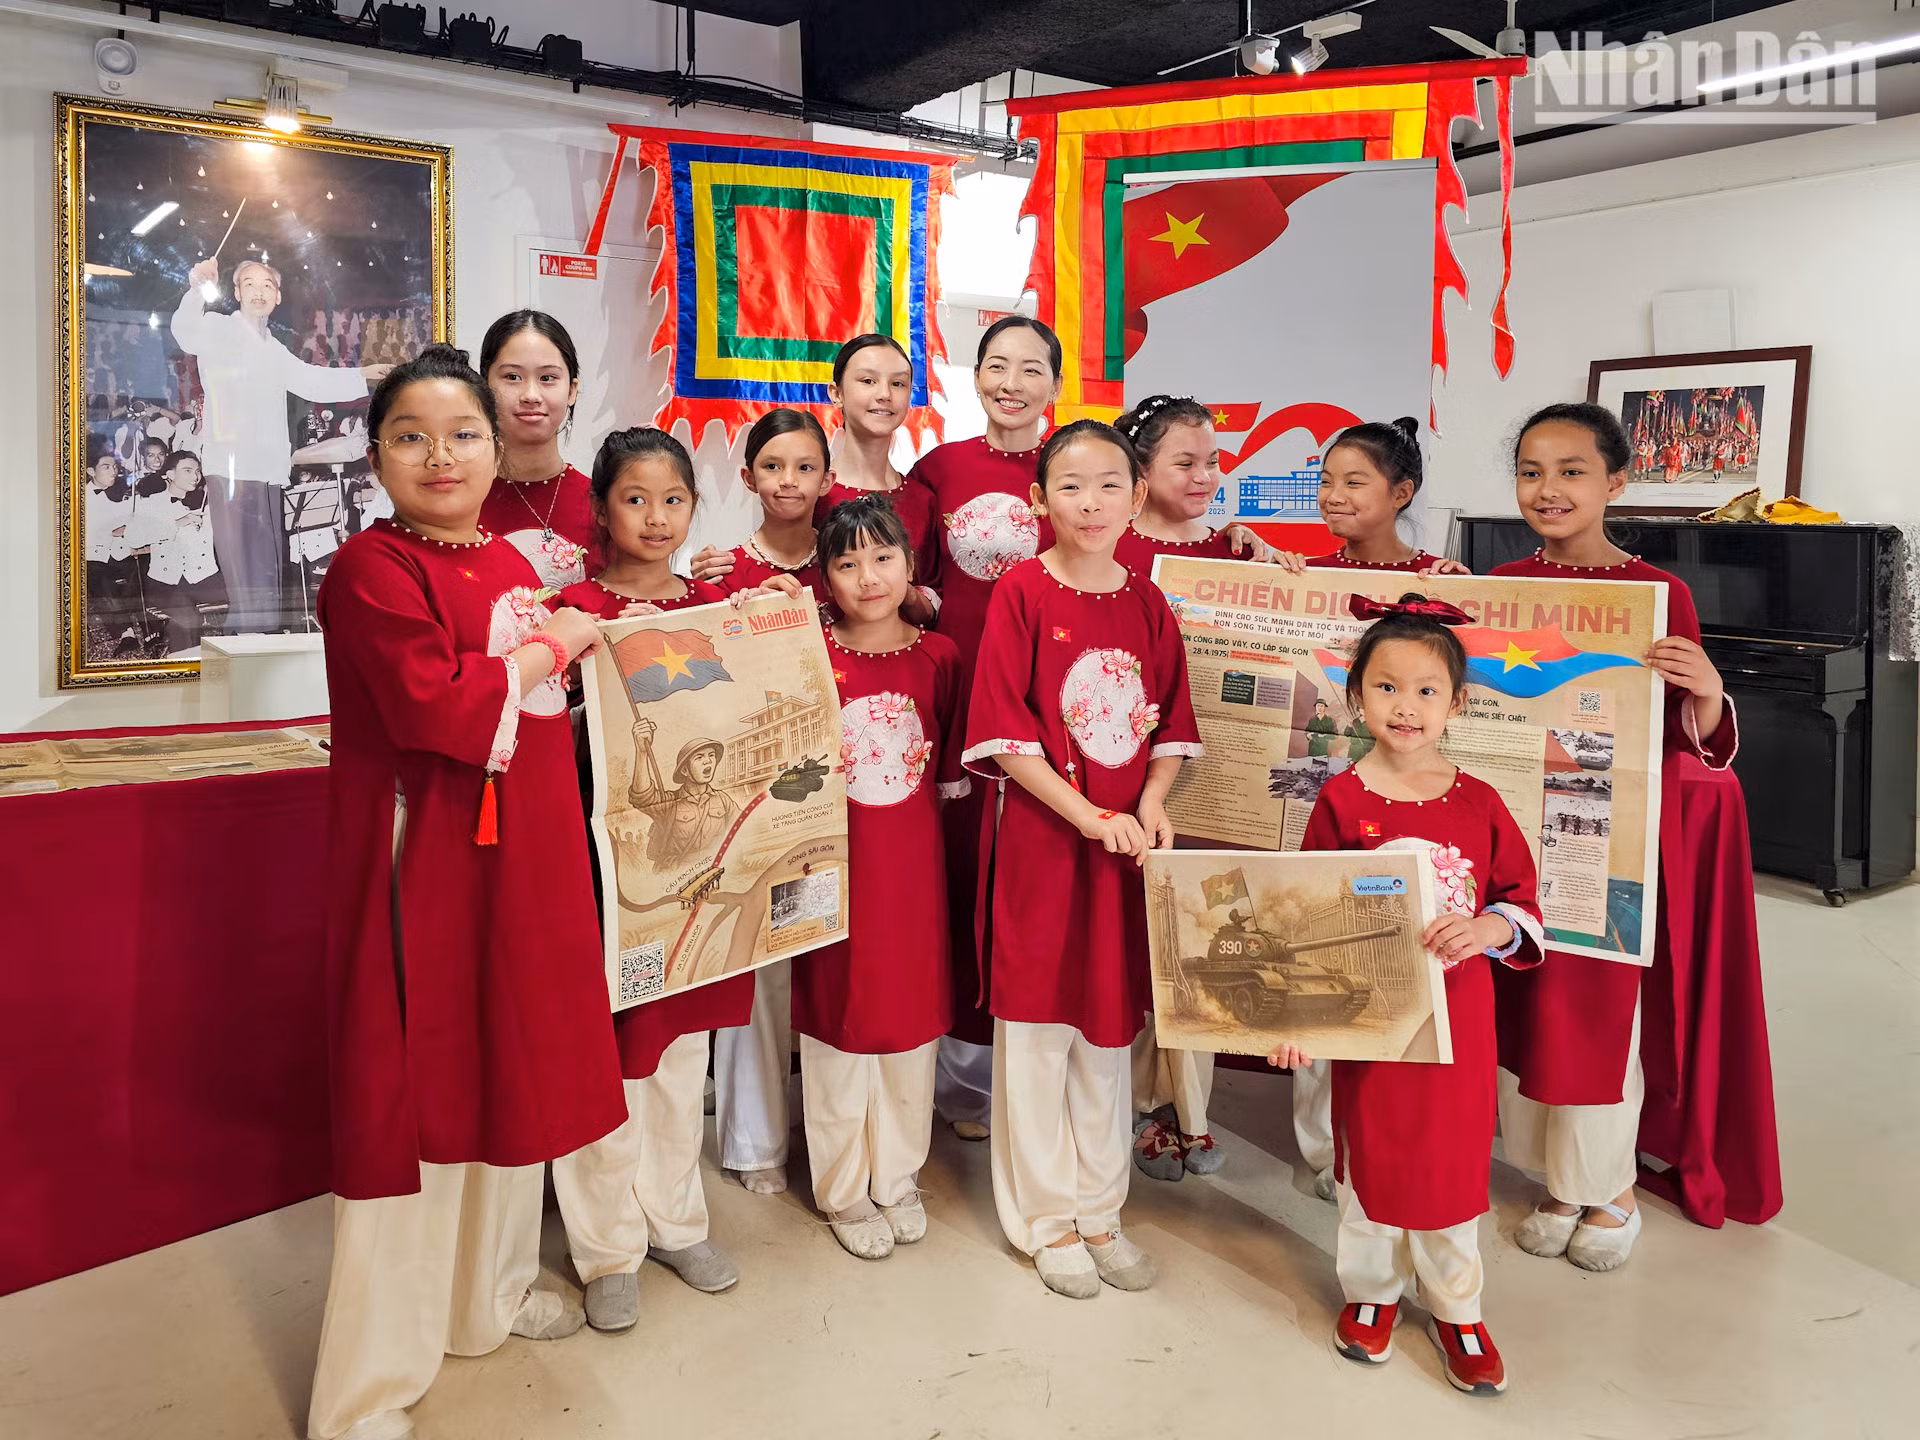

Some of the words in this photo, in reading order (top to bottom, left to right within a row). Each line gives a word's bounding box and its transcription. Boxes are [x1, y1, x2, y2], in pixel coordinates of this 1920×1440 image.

[1195, 578, 1295, 612] CHIẾN
[1236, 613, 1252, 621] CAO
[1532, 603, 1631, 635] MINH
[1218, 940, 1242, 955] 390
